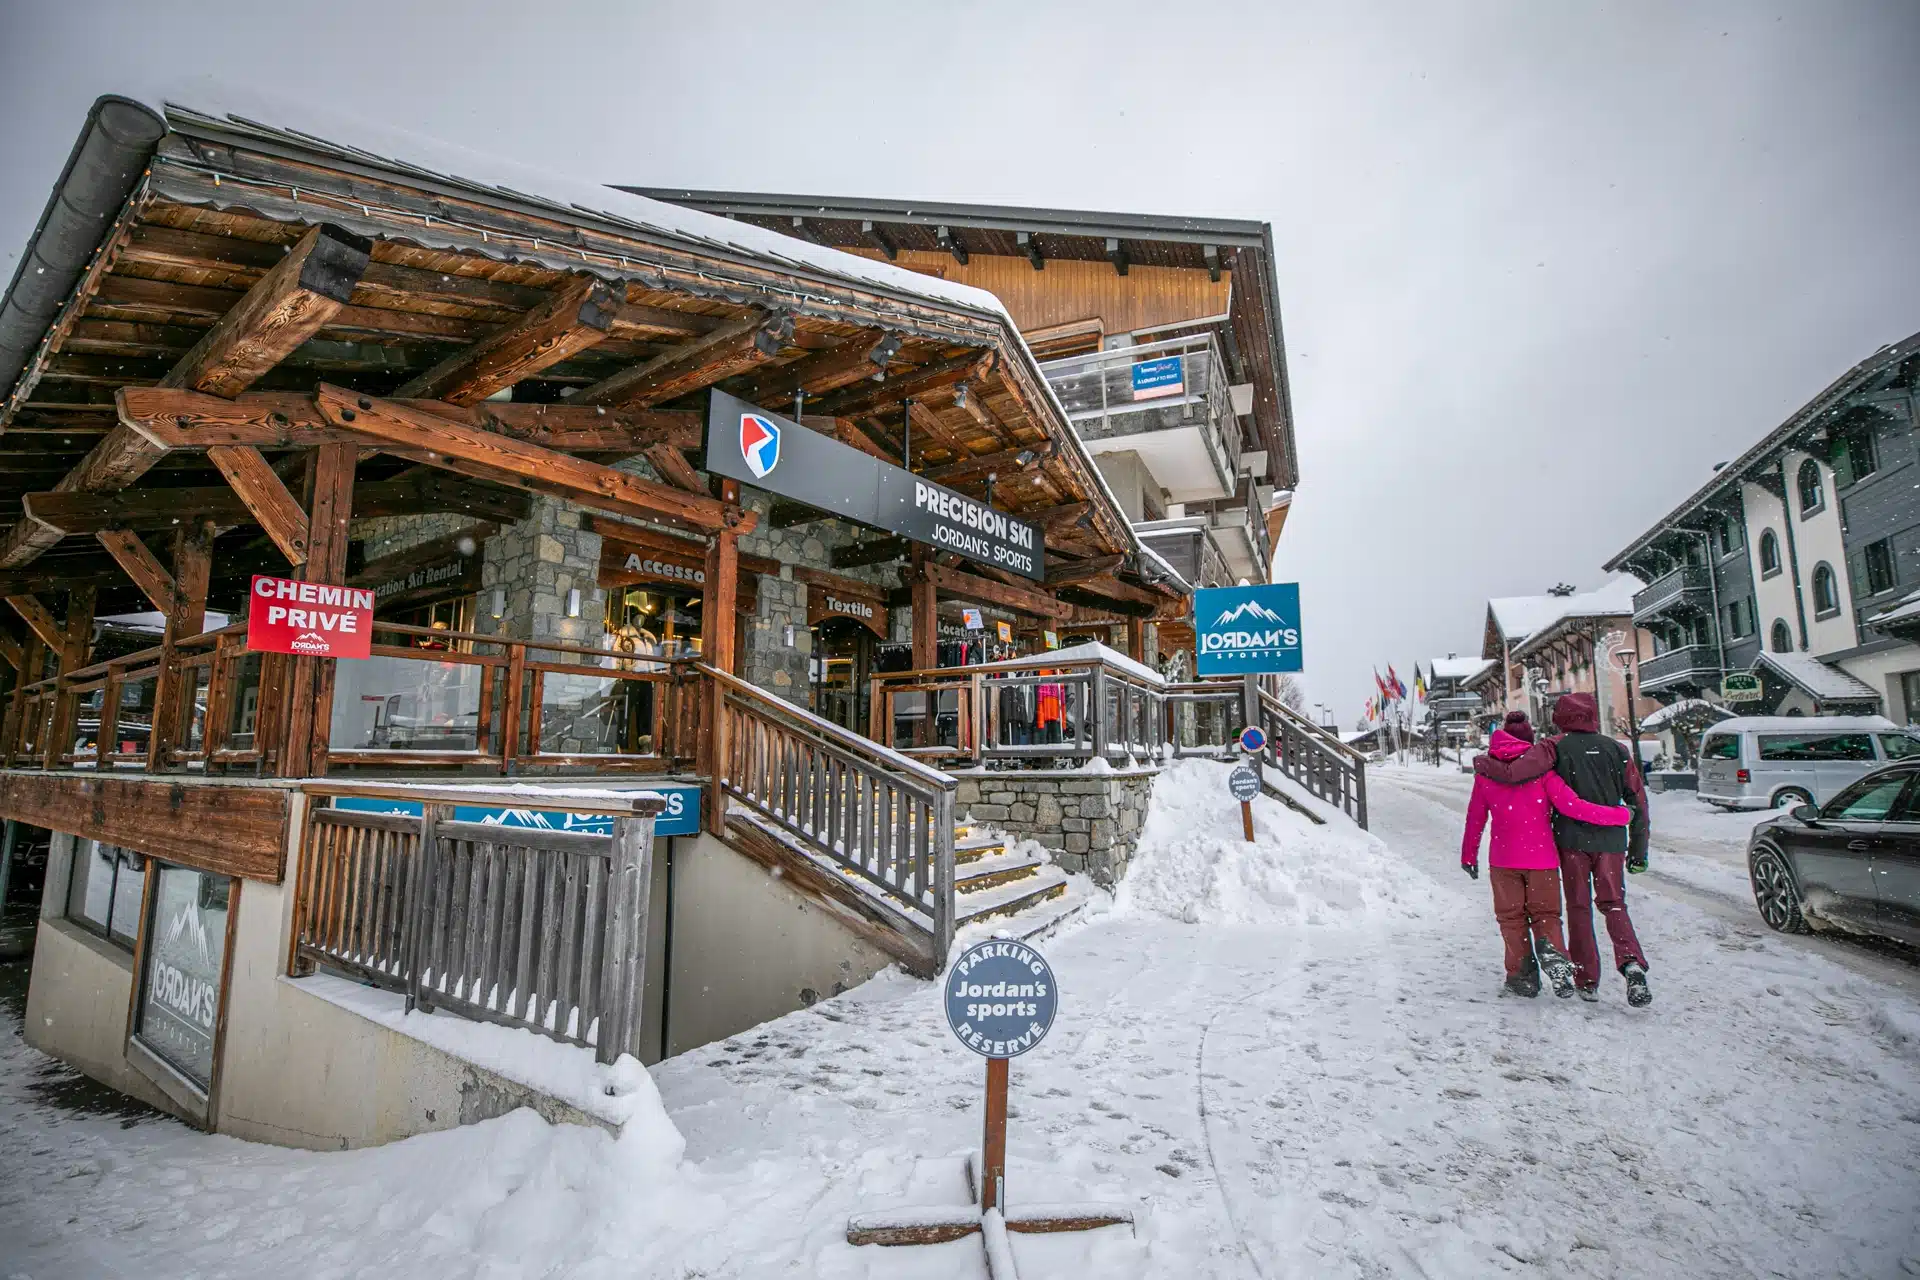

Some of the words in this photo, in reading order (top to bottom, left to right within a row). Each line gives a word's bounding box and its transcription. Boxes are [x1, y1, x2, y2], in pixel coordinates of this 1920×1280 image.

[915, 481, 1007, 541] PRECISION
[1009, 520, 1033, 550] SKI
[931, 523, 989, 558] JORDAN'S
[993, 545, 1032, 573] SPORTS
[426, 560, 462, 583] Rental
[255, 577, 373, 610] CHEMIN
[826, 596, 873, 618] Textile
[268, 605, 358, 633] PRIVÉ
[1200, 629, 1299, 655] JORDAN'S
[1217, 651, 1282, 660] SPORTS
[1231, 767, 1256, 779] PARKING
[1235, 784, 1256, 792] sports
[958, 944, 1045, 976] PARKING
[150, 958, 214, 1028] JORDAN'S
[955, 981, 1047, 997] Jordan's
[966, 1001, 1037, 1021] sports
[156, 1018, 197, 1054] SPORTS
[957, 1021, 1044, 1055] RÉSERVÉ
